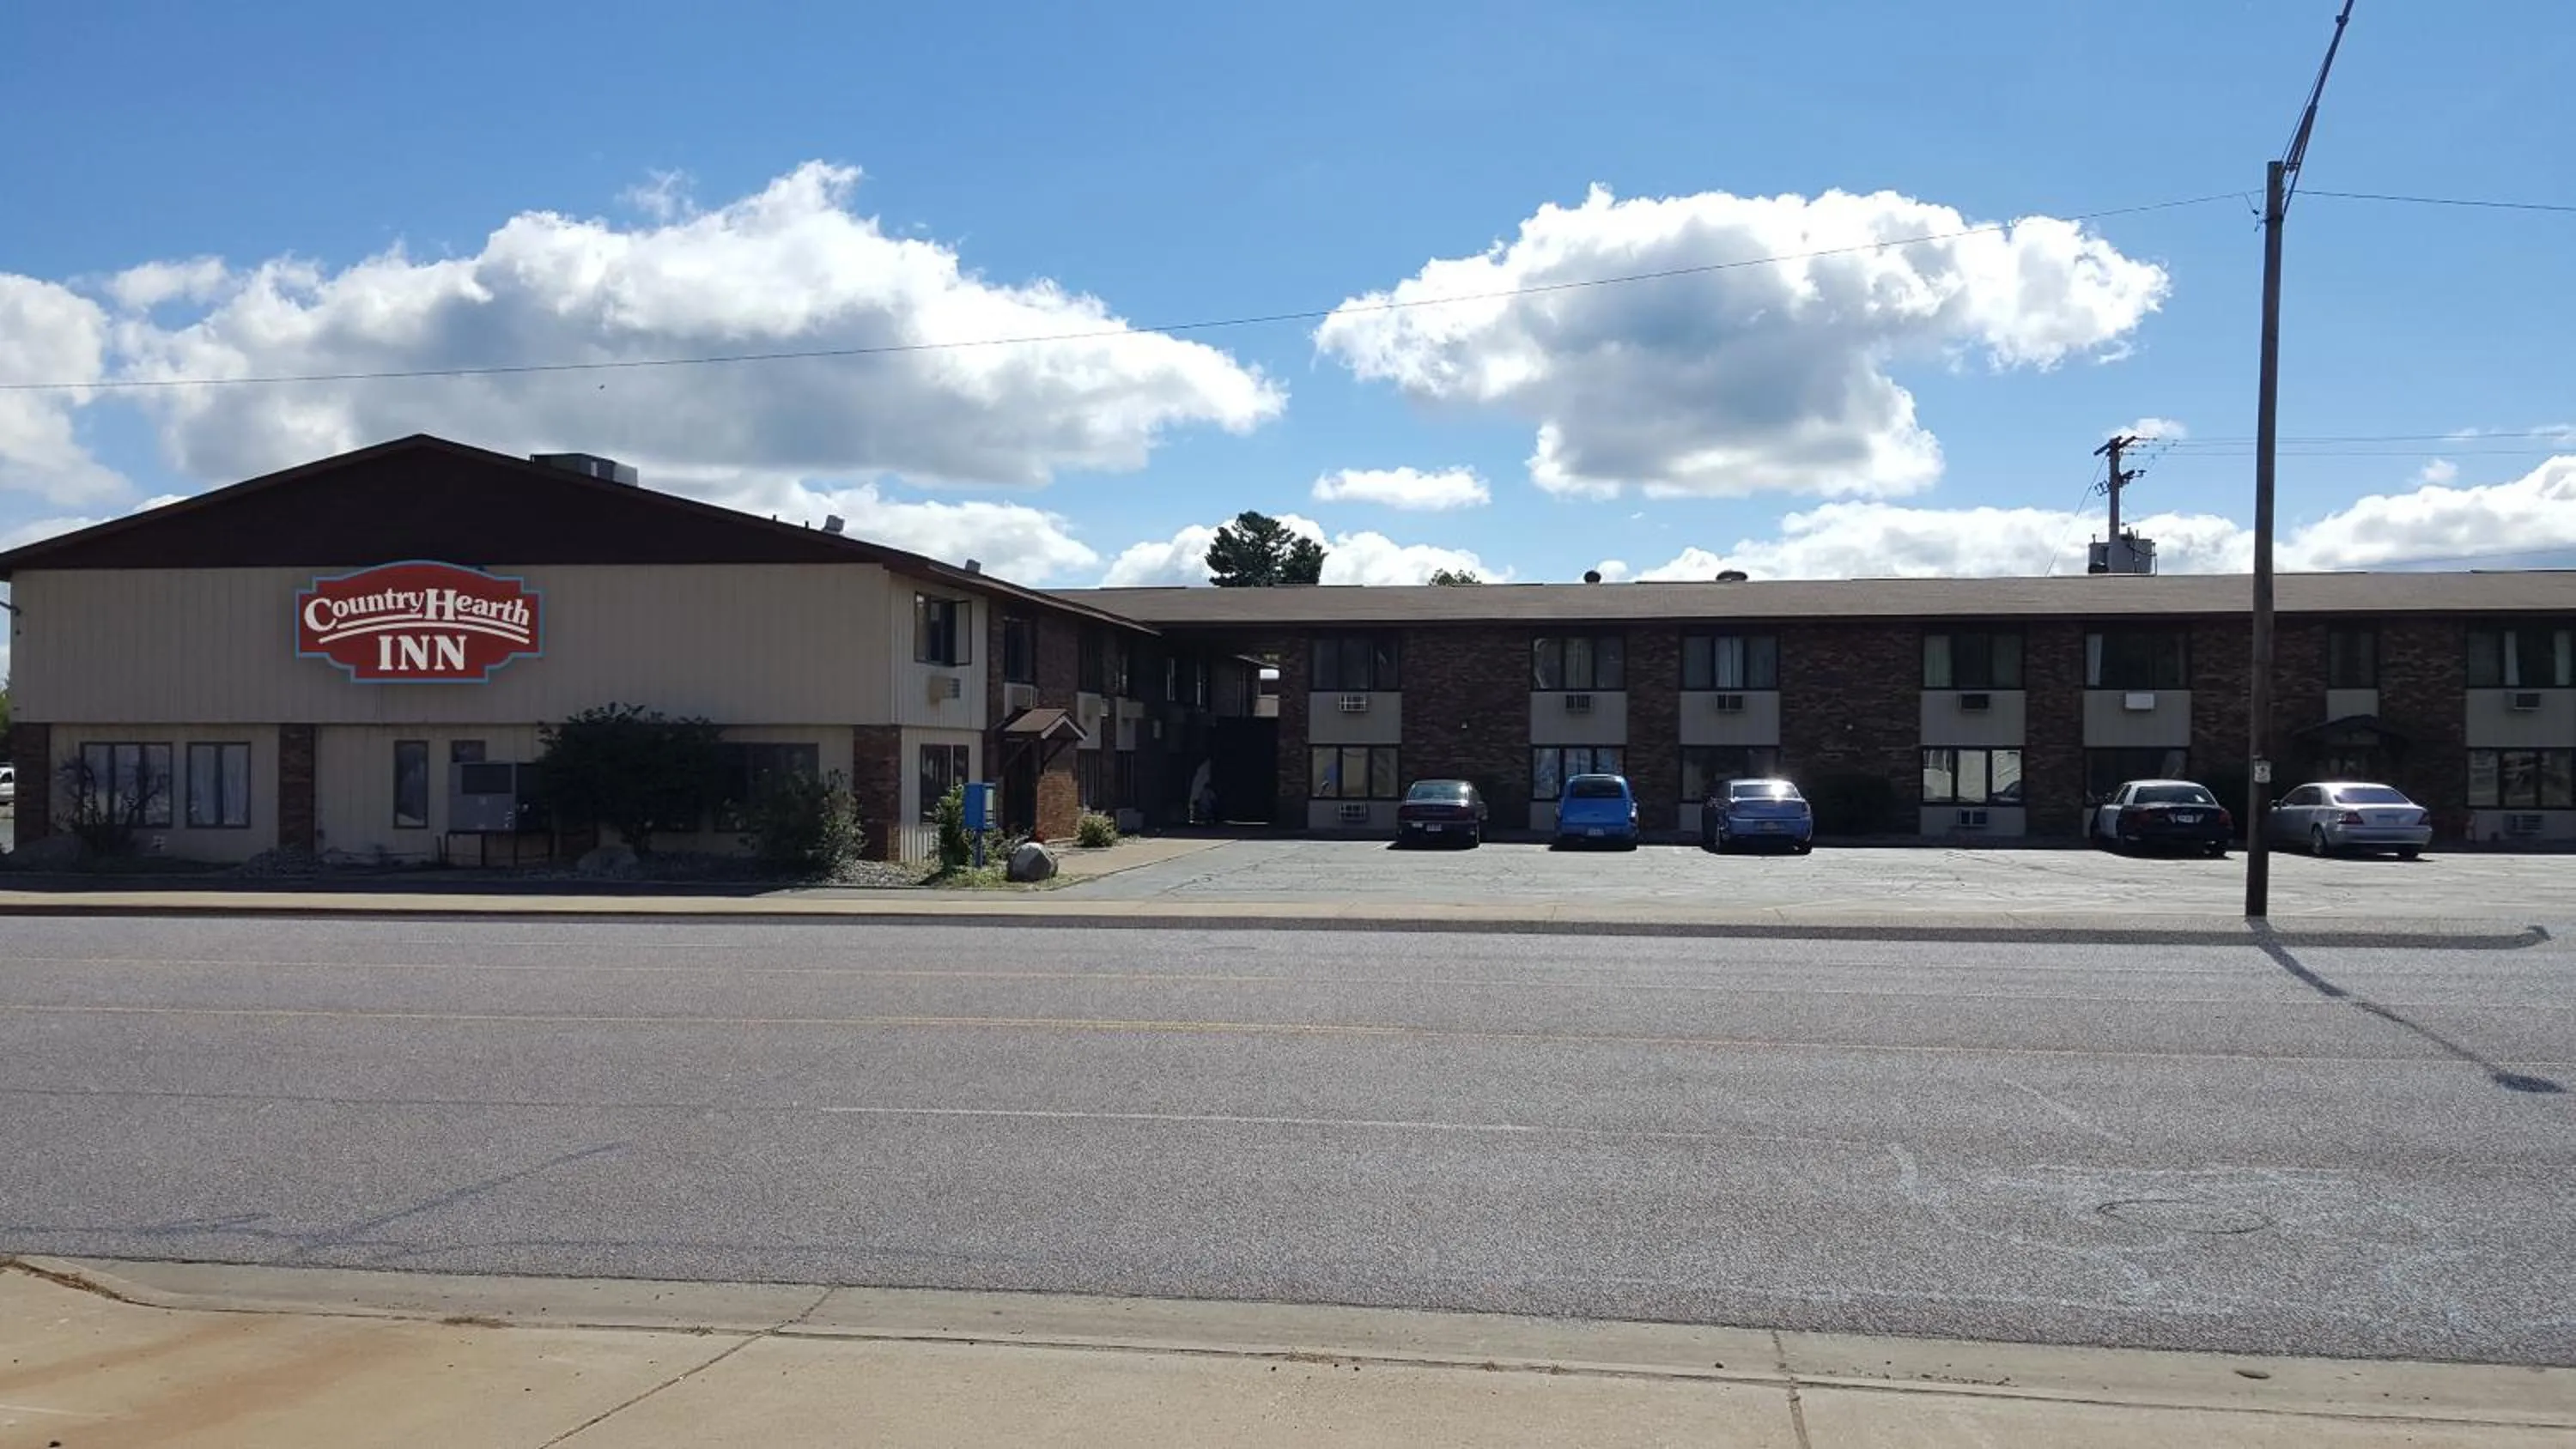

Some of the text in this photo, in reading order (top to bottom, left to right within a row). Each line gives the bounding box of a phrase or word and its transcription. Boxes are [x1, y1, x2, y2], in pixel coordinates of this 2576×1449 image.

[304, 588, 530, 632] Country Hearth
[378, 634, 467, 671] INN
